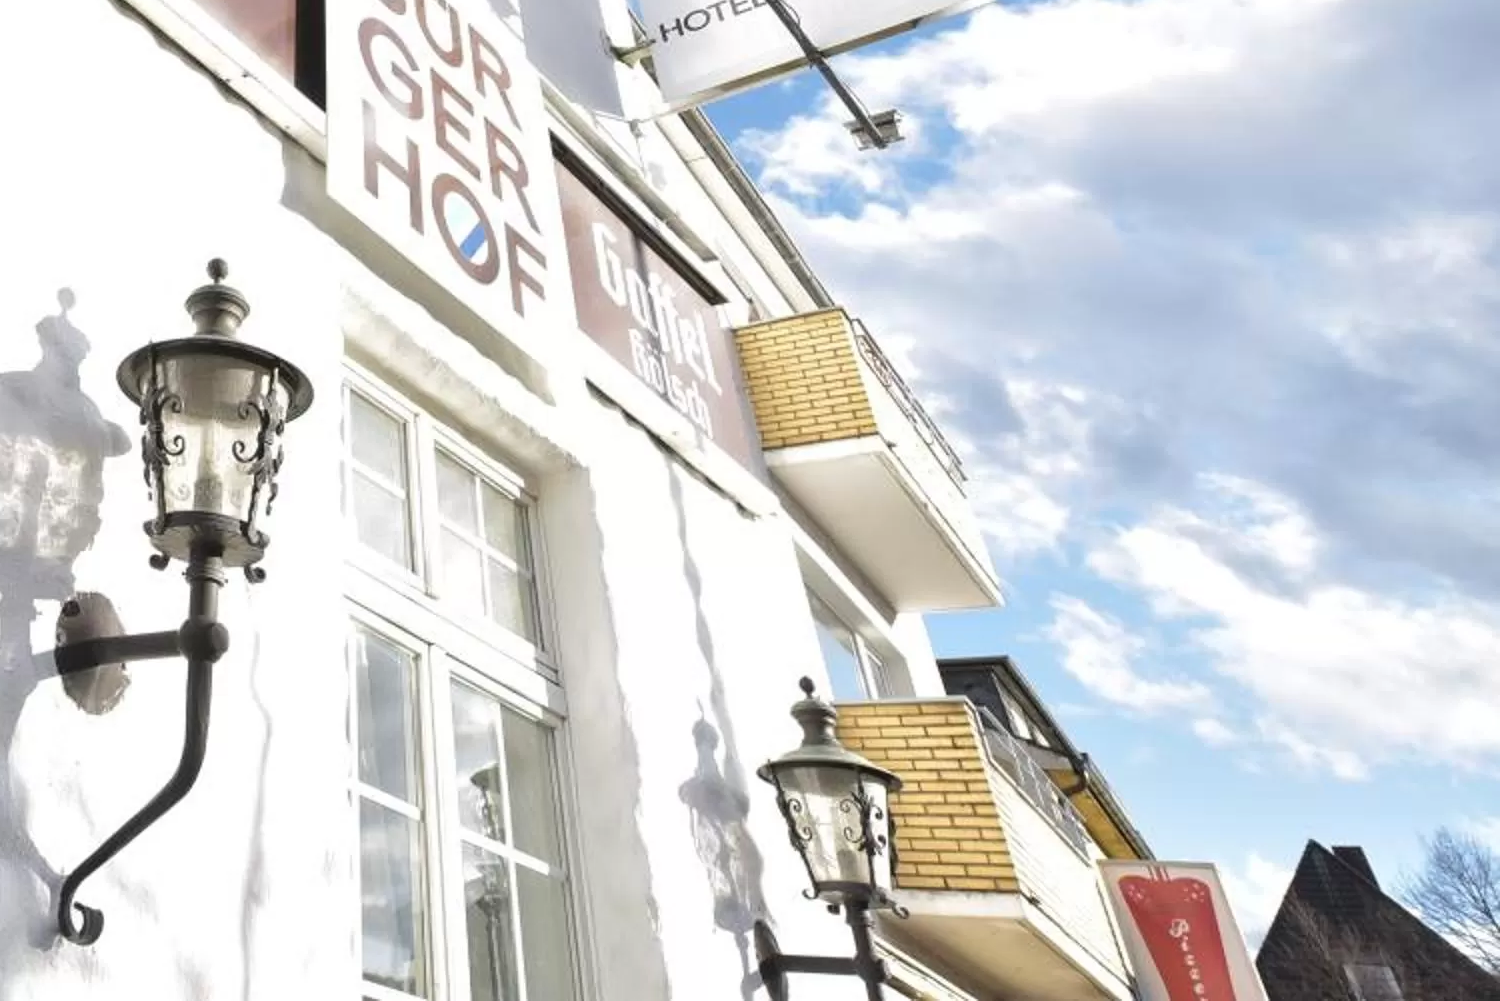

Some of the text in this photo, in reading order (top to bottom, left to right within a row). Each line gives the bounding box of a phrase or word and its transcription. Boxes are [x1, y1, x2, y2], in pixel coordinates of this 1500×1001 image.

[357, 17, 542, 235] GER
[362, 99, 547, 319] HOF
[592, 222, 722, 397] Gaffel
